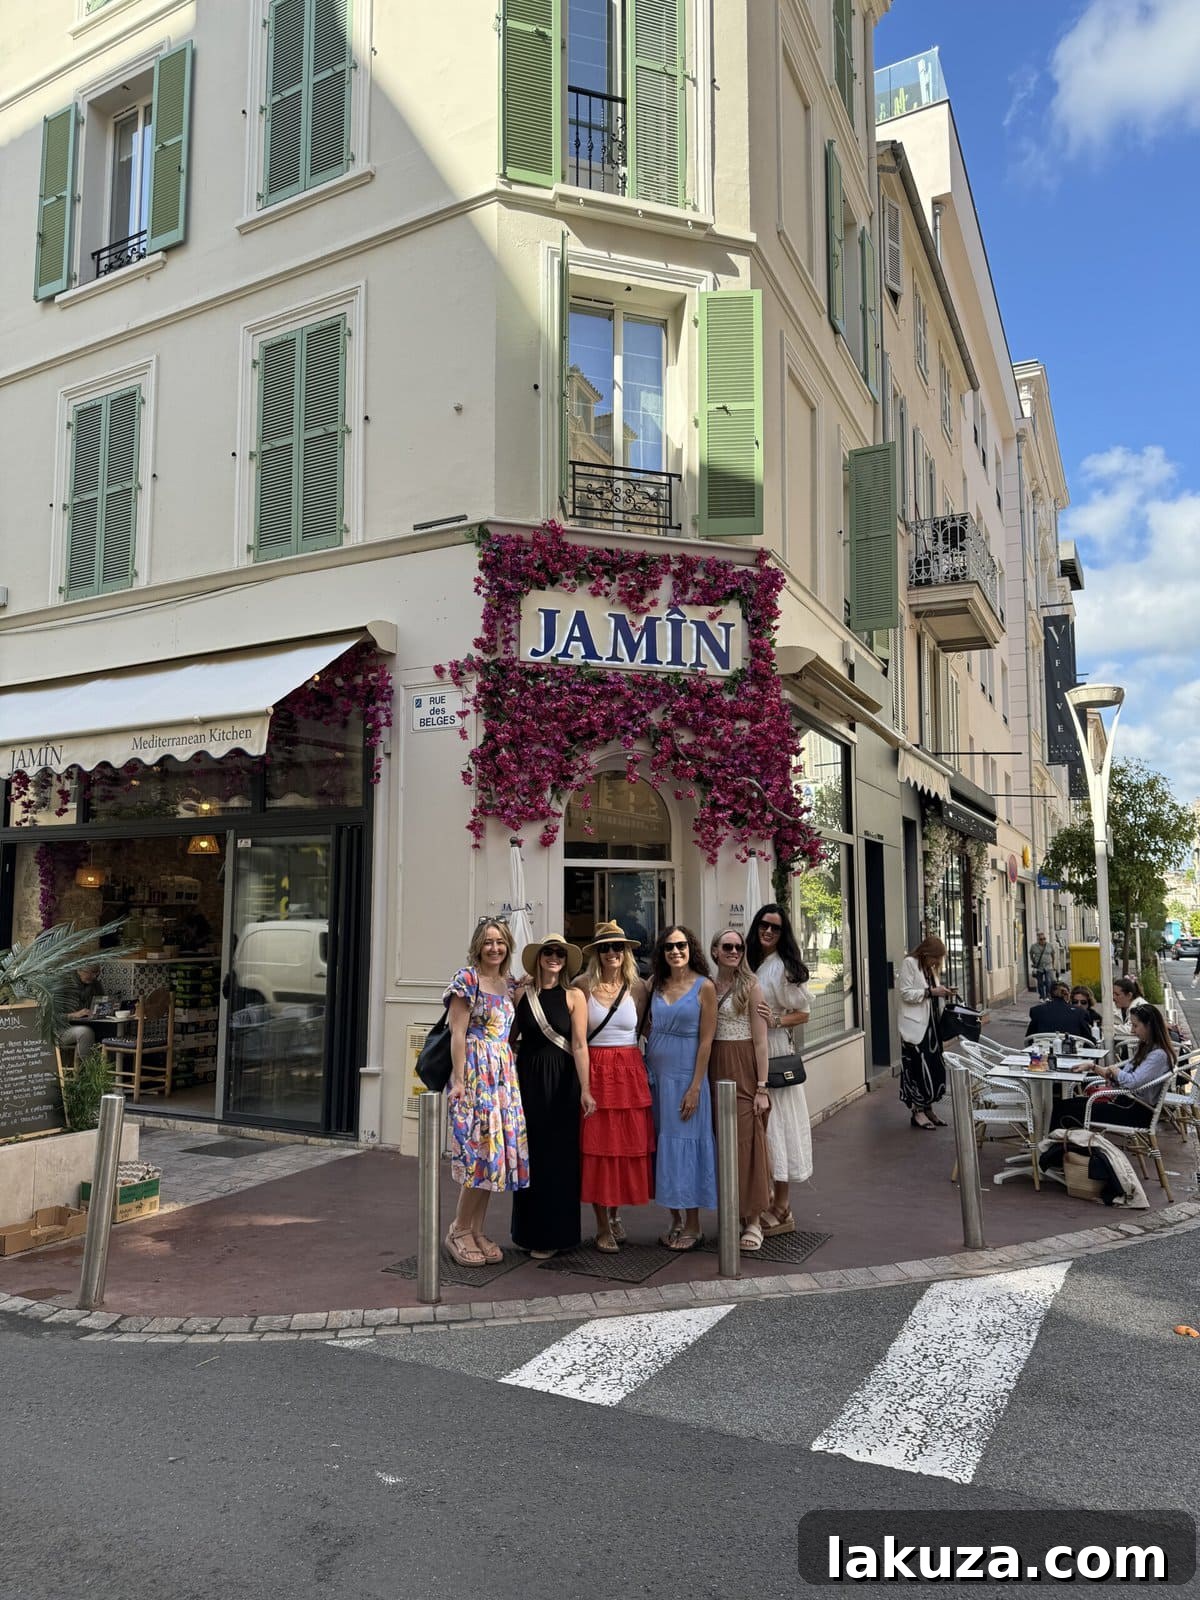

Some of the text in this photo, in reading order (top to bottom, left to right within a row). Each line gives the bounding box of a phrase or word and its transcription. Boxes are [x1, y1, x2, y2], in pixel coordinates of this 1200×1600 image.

[530, 606, 735, 670] JAMÎN
[430, 696, 446, 705] RUE
[430, 707, 446, 716] des
[419, 715, 456, 727] BELGES
[8, 726, 252, 776] JAMÎN Mediterranean Kitchen
